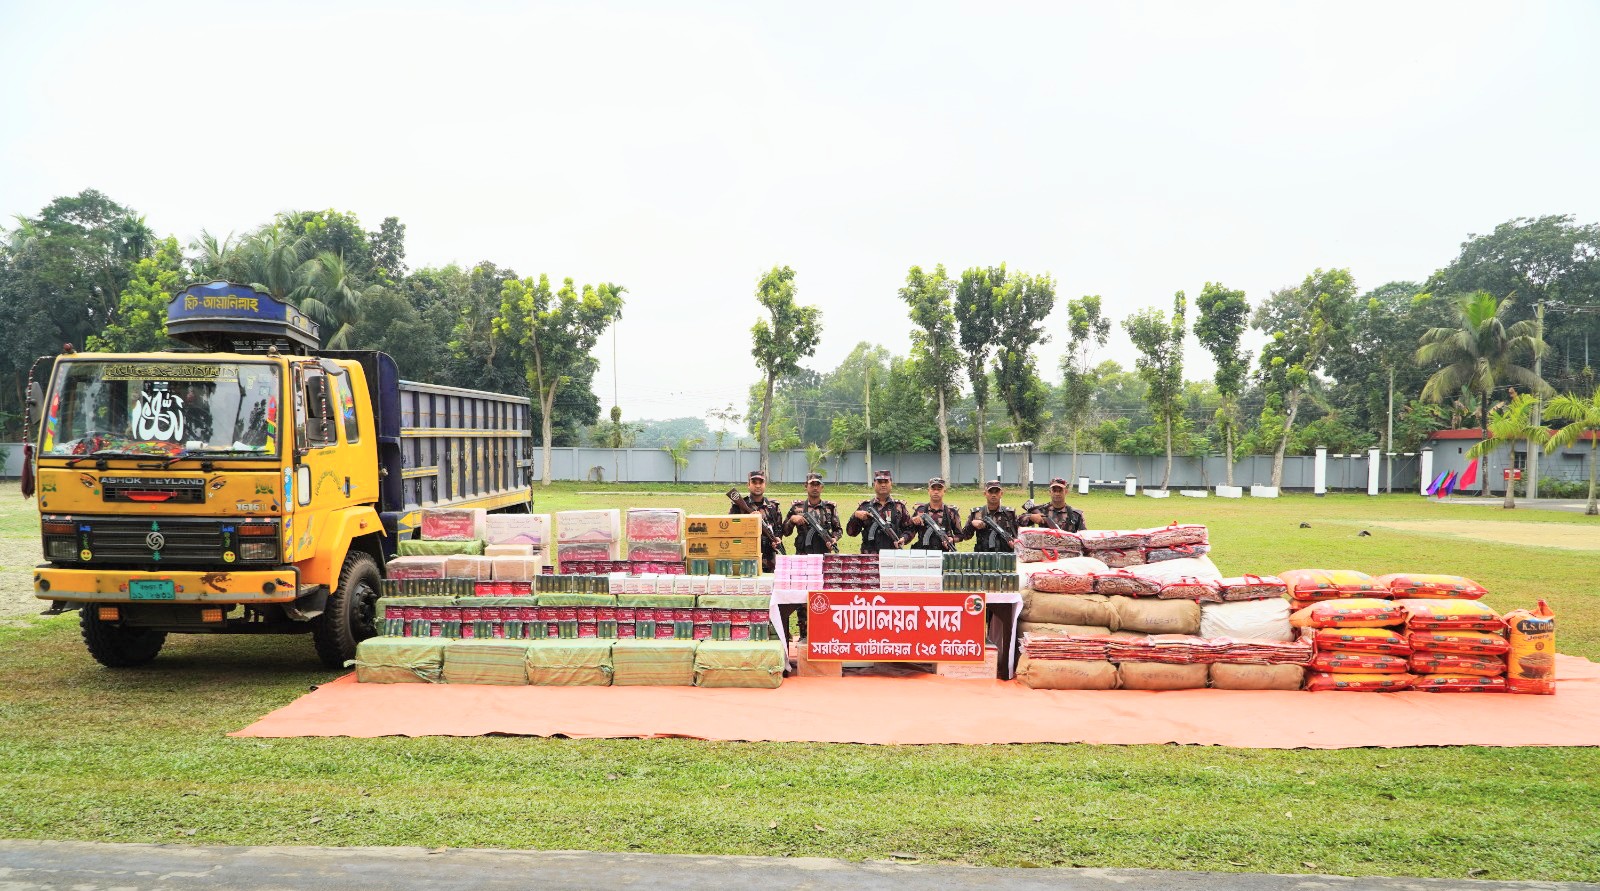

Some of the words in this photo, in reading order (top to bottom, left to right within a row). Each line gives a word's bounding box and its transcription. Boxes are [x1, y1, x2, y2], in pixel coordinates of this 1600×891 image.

[100, 477, 142, 485] ASHOK
[149, 477, 205, 486] LEYLAND
[829, 594, 920, 633] ব্যাটালিয়ন
[923, 605, 963, 632] সদর
[811, 638, 851, 656] সরাইল
[853, 638, 912, 656] ব্যাটালিয়ন
[915, 642, 937, 656] (২৫
[940, 639, 982, 657] বিজিবি)
